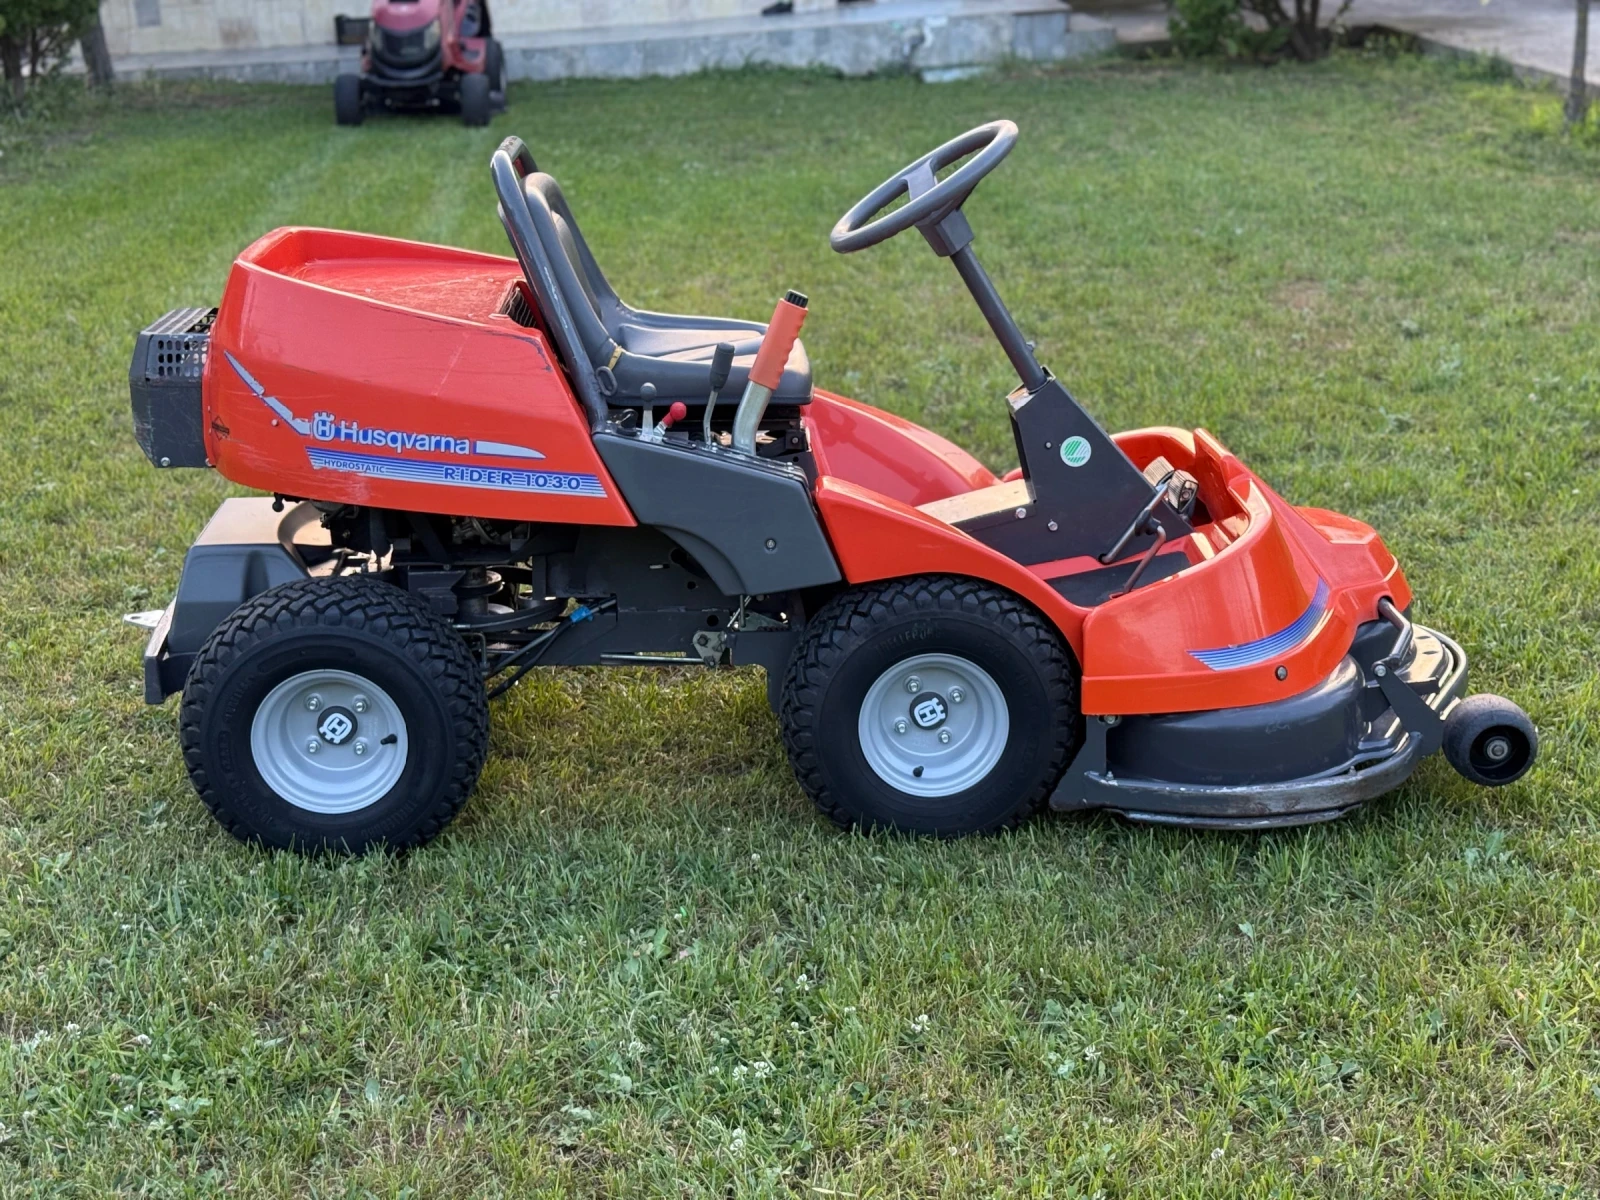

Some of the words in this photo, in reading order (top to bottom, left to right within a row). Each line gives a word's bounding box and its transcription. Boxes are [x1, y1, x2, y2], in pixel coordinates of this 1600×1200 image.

[340, 420, 470, 454] Husqvarna
[324, 459, 385, 473] HYDROSTATIC
[444, 467, 513, 485] RIDER
[525, 474, 581, 490] 1030
